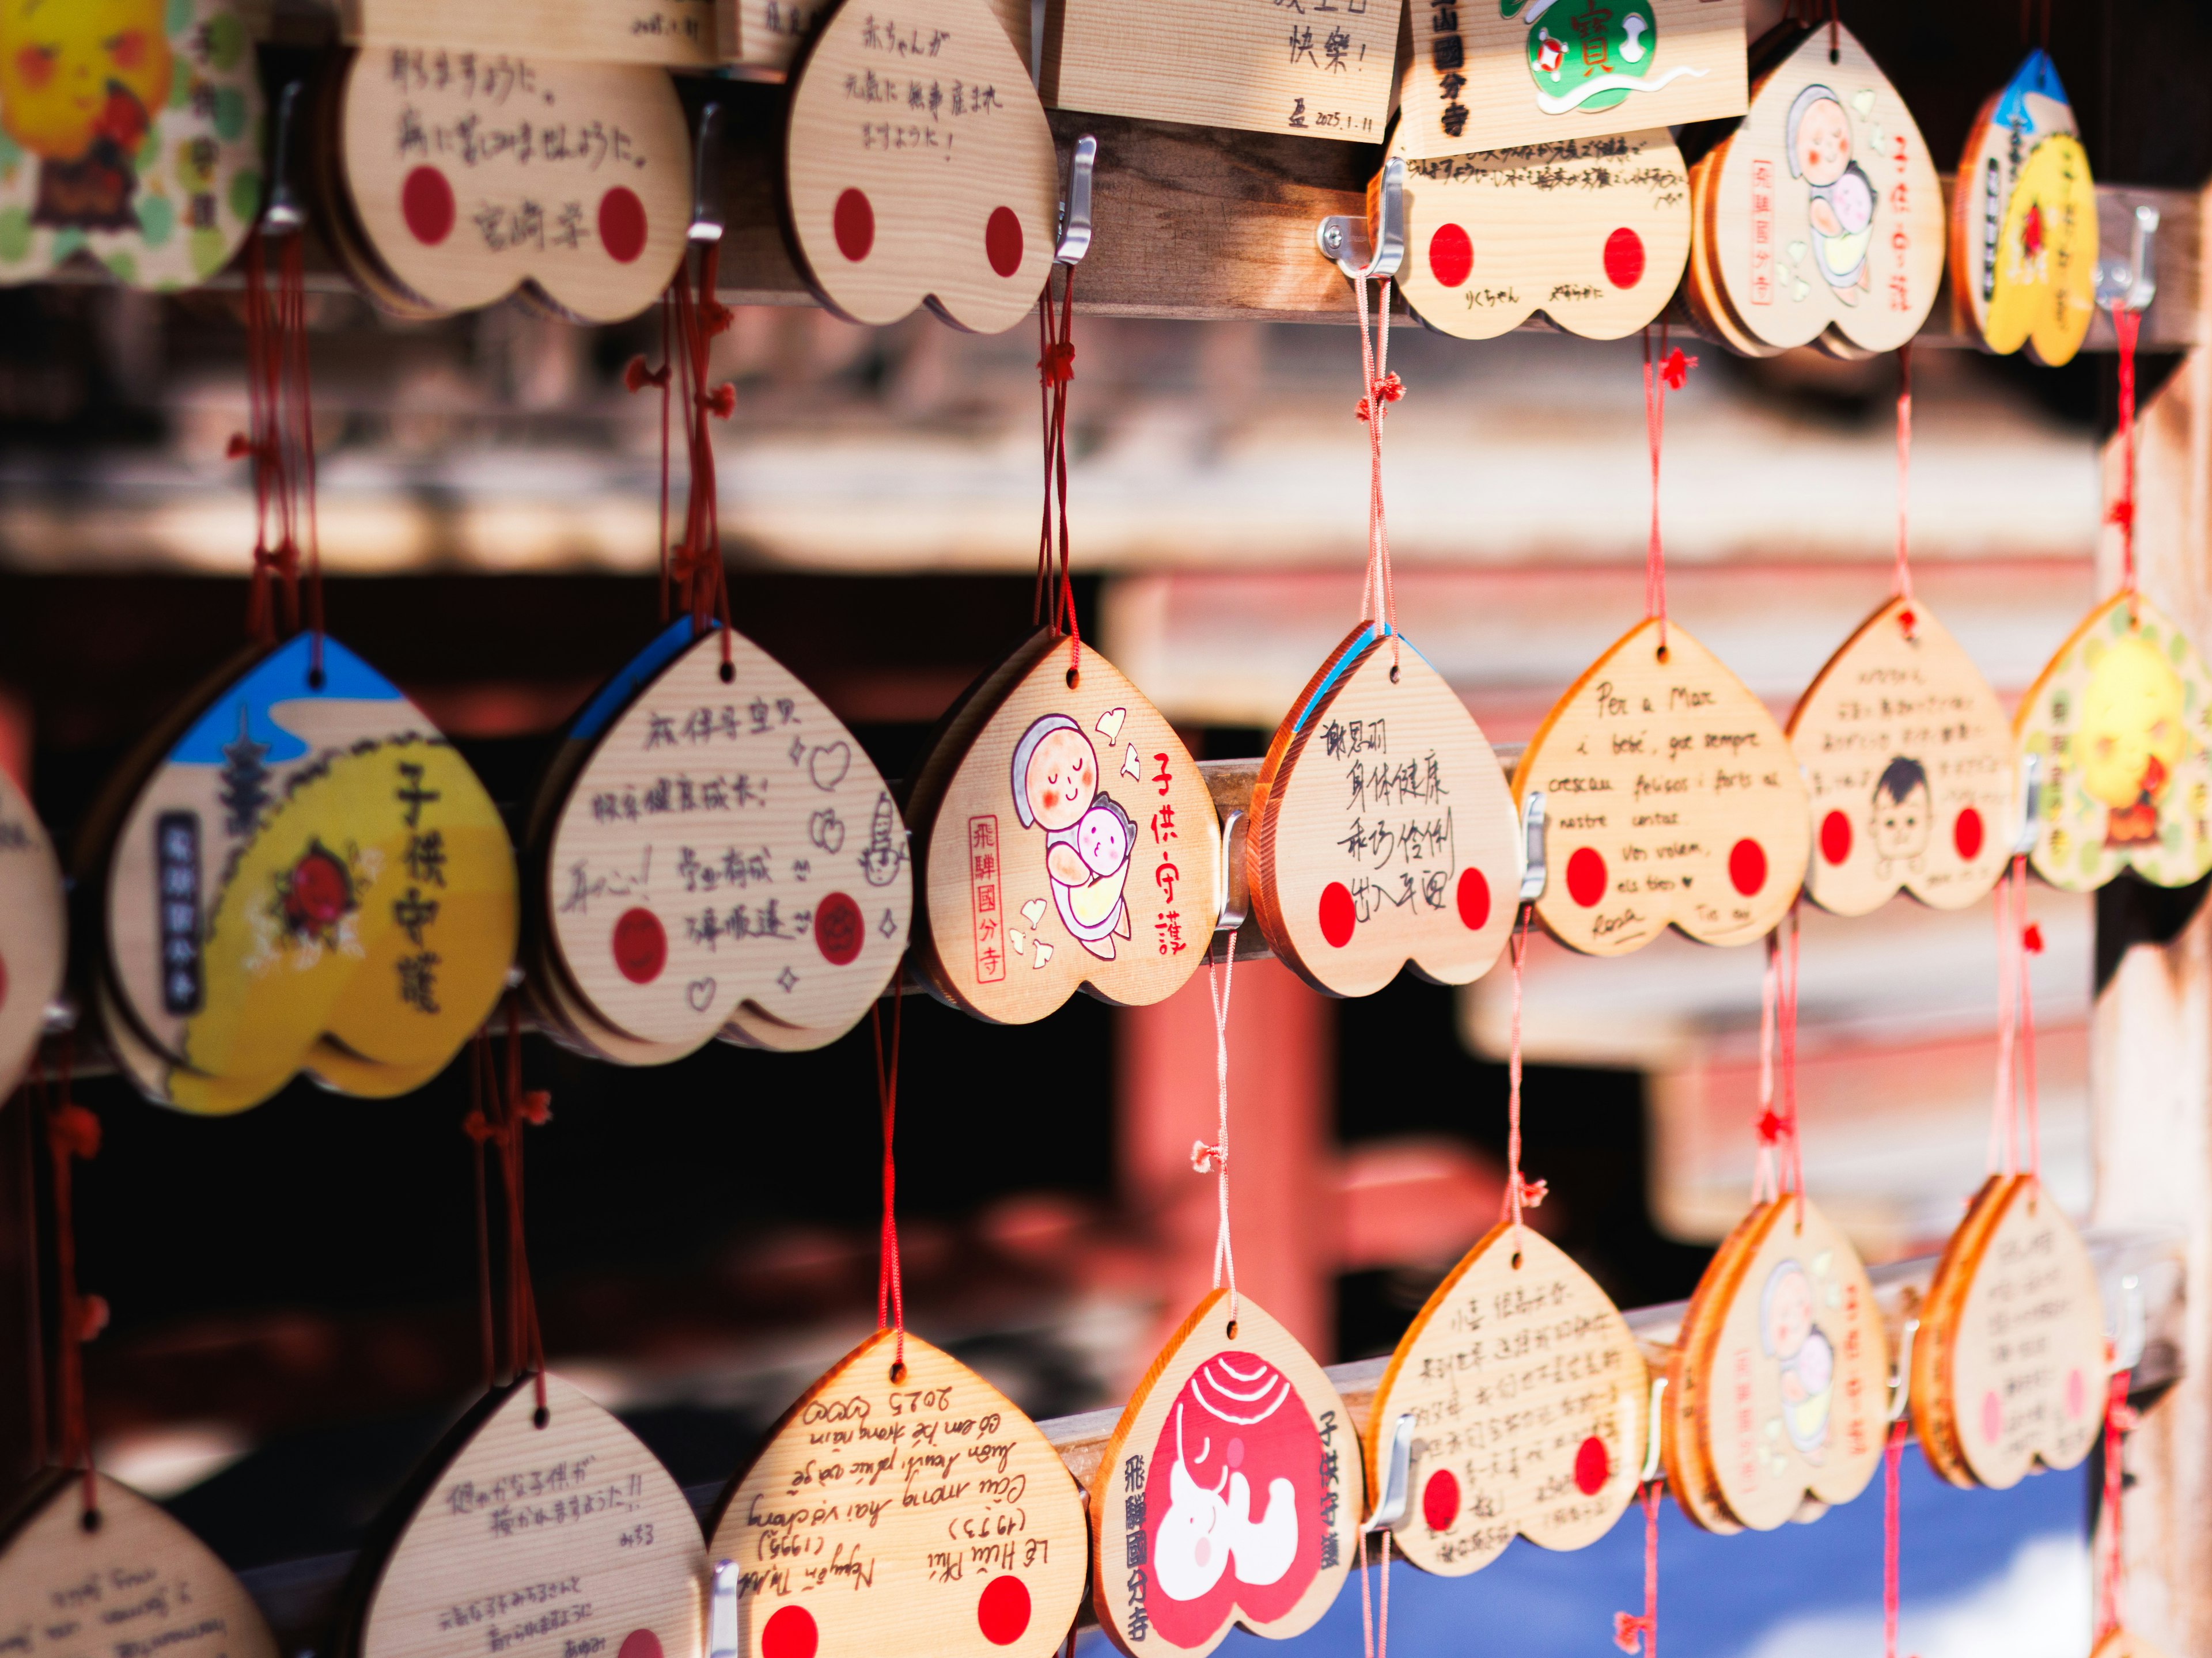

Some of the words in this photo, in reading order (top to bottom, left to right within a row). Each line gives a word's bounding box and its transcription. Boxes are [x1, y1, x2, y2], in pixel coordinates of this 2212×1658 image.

[862, 14, 950, 58] 赤ちゃんが
[1431, 0, 1470, 137] 山國分寺
[1596, 681, 1628, 719] Per
[1642, 697, 1654, 714] a
[1670, 686, 1718, 712] Mar
[1703, 731, 1760, 758] sempre
[1346, 749, 1450, 813] 身体健康
[1150, 752, 1187, 956] 子供守護
[974, 822, 1002, 977] 飛騨國分寺
[889, 1386, 953, 1417] 2025
[944, 1420, 976, 1436] em
[902, 1469, 969, 1508] mong
[979, 1474, 1026, 1511] Cầu
[847, 1498, 892, 1528] hai
[801, 1543, 874, 1592] Nguyễn
[1025, 1539, 1048, 1566] Lê
